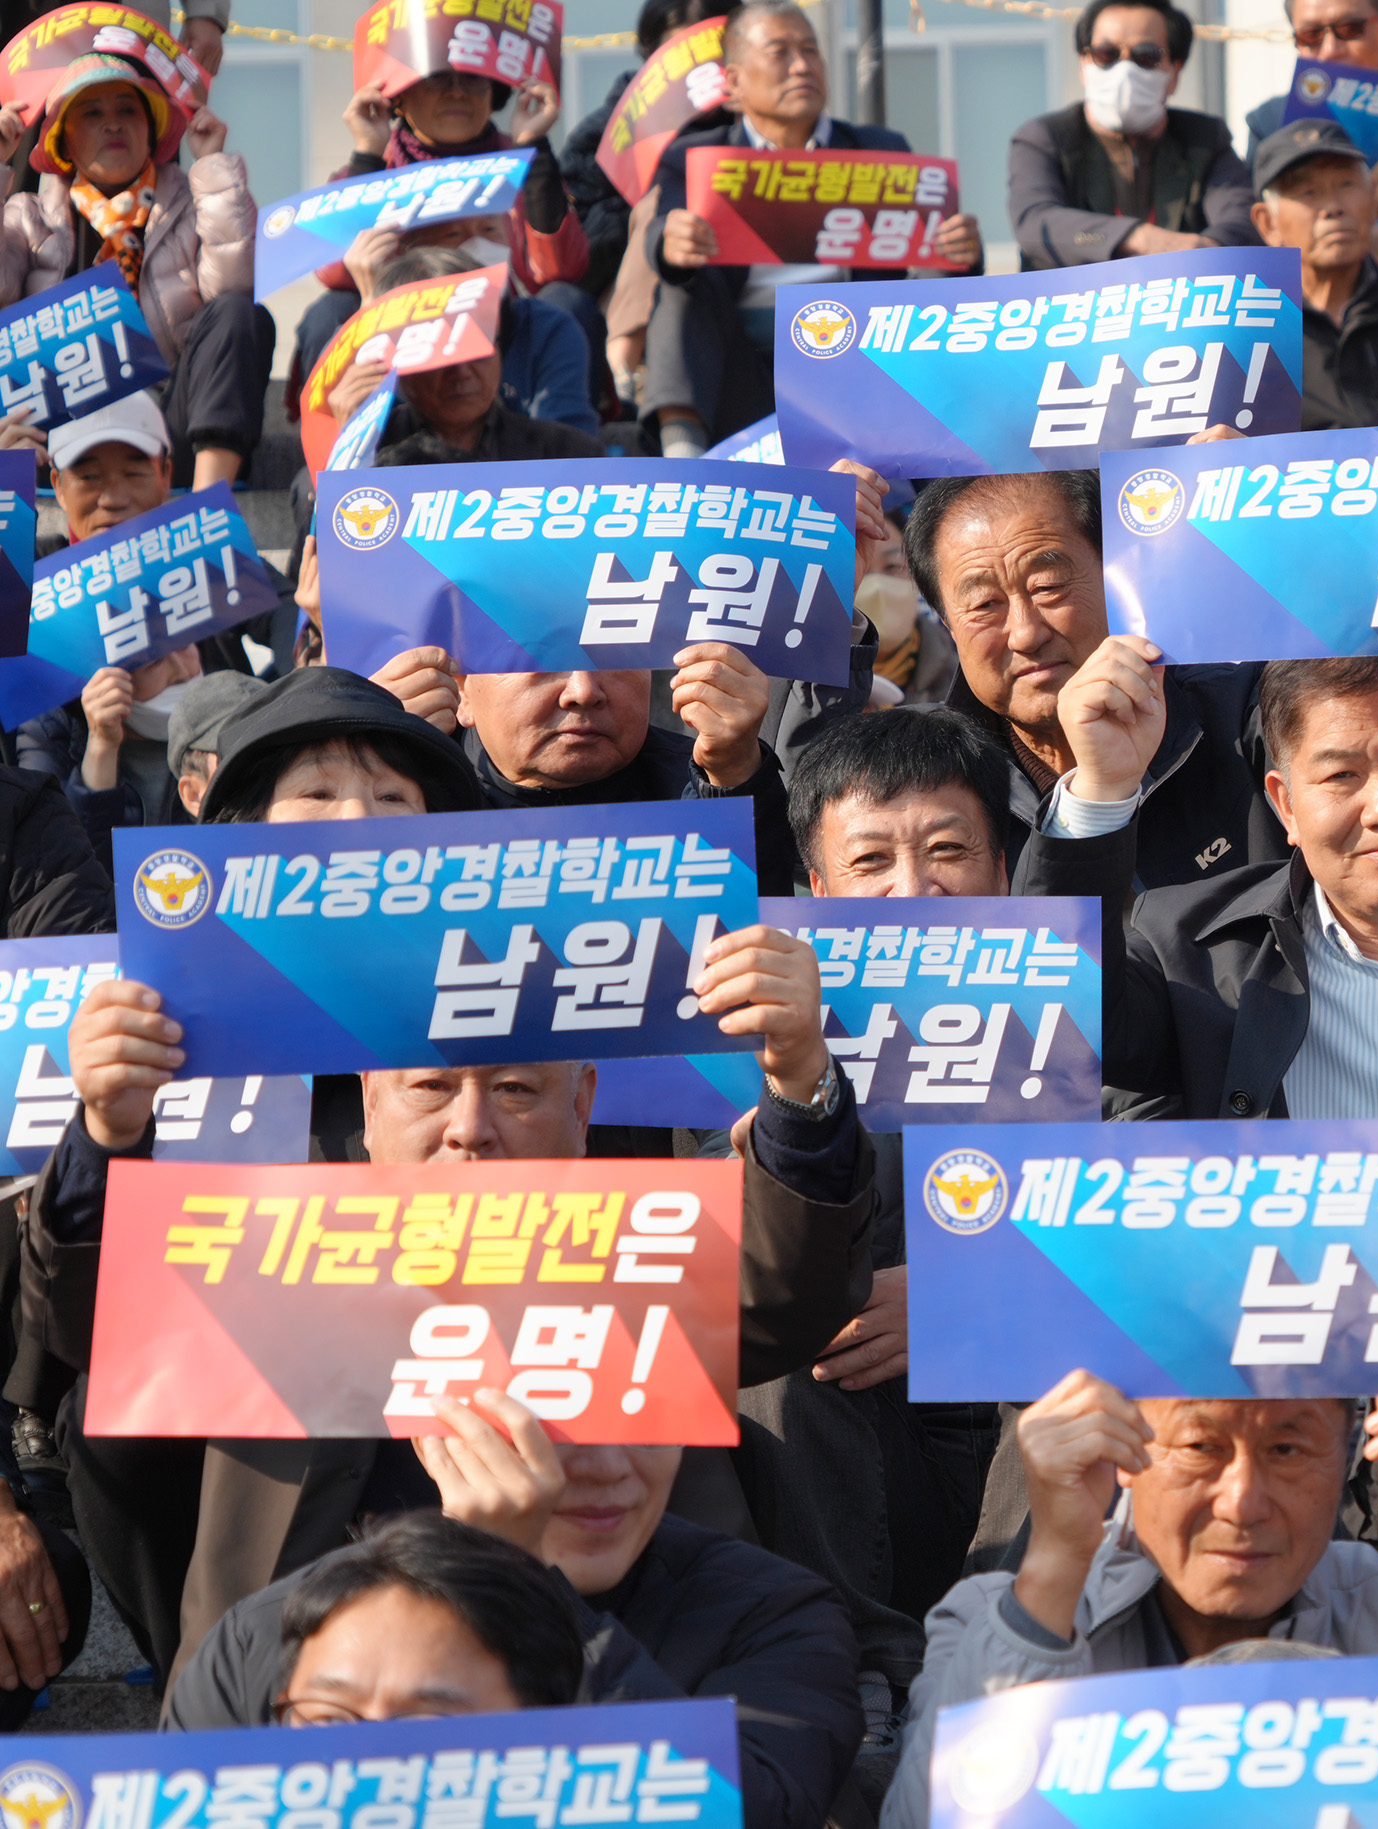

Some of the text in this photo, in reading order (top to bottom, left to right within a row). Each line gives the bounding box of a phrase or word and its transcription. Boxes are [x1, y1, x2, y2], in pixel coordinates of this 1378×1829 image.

[712, 160, 948, 204] 국가균형발전은
[815, 208, 942, 260] 운명!
[859, 274, 1282, 353] 제2중앙경찰학교는
[1029, 342, 1270, 449] 남원!
[402, 482, 837, 550] 제2중앙경찰학교는
[29, 507, 229, 622] 중앙경찰학교는
[96, 545, 241, 664] 남원!
[579, 552, 824, 648] 남원!
[214, 833, 731, 919] 제2중앙경찰학교는
[1195, 837, 1232, 870] K2
[428, 914, 718, 1041] 남원!
[164, 1191, 701, 1285] 국가균형발전은
[382, 1305, 669, 1420] 운명!
[86, 1741, 709, 1829] 제2중앙경찰학교는
